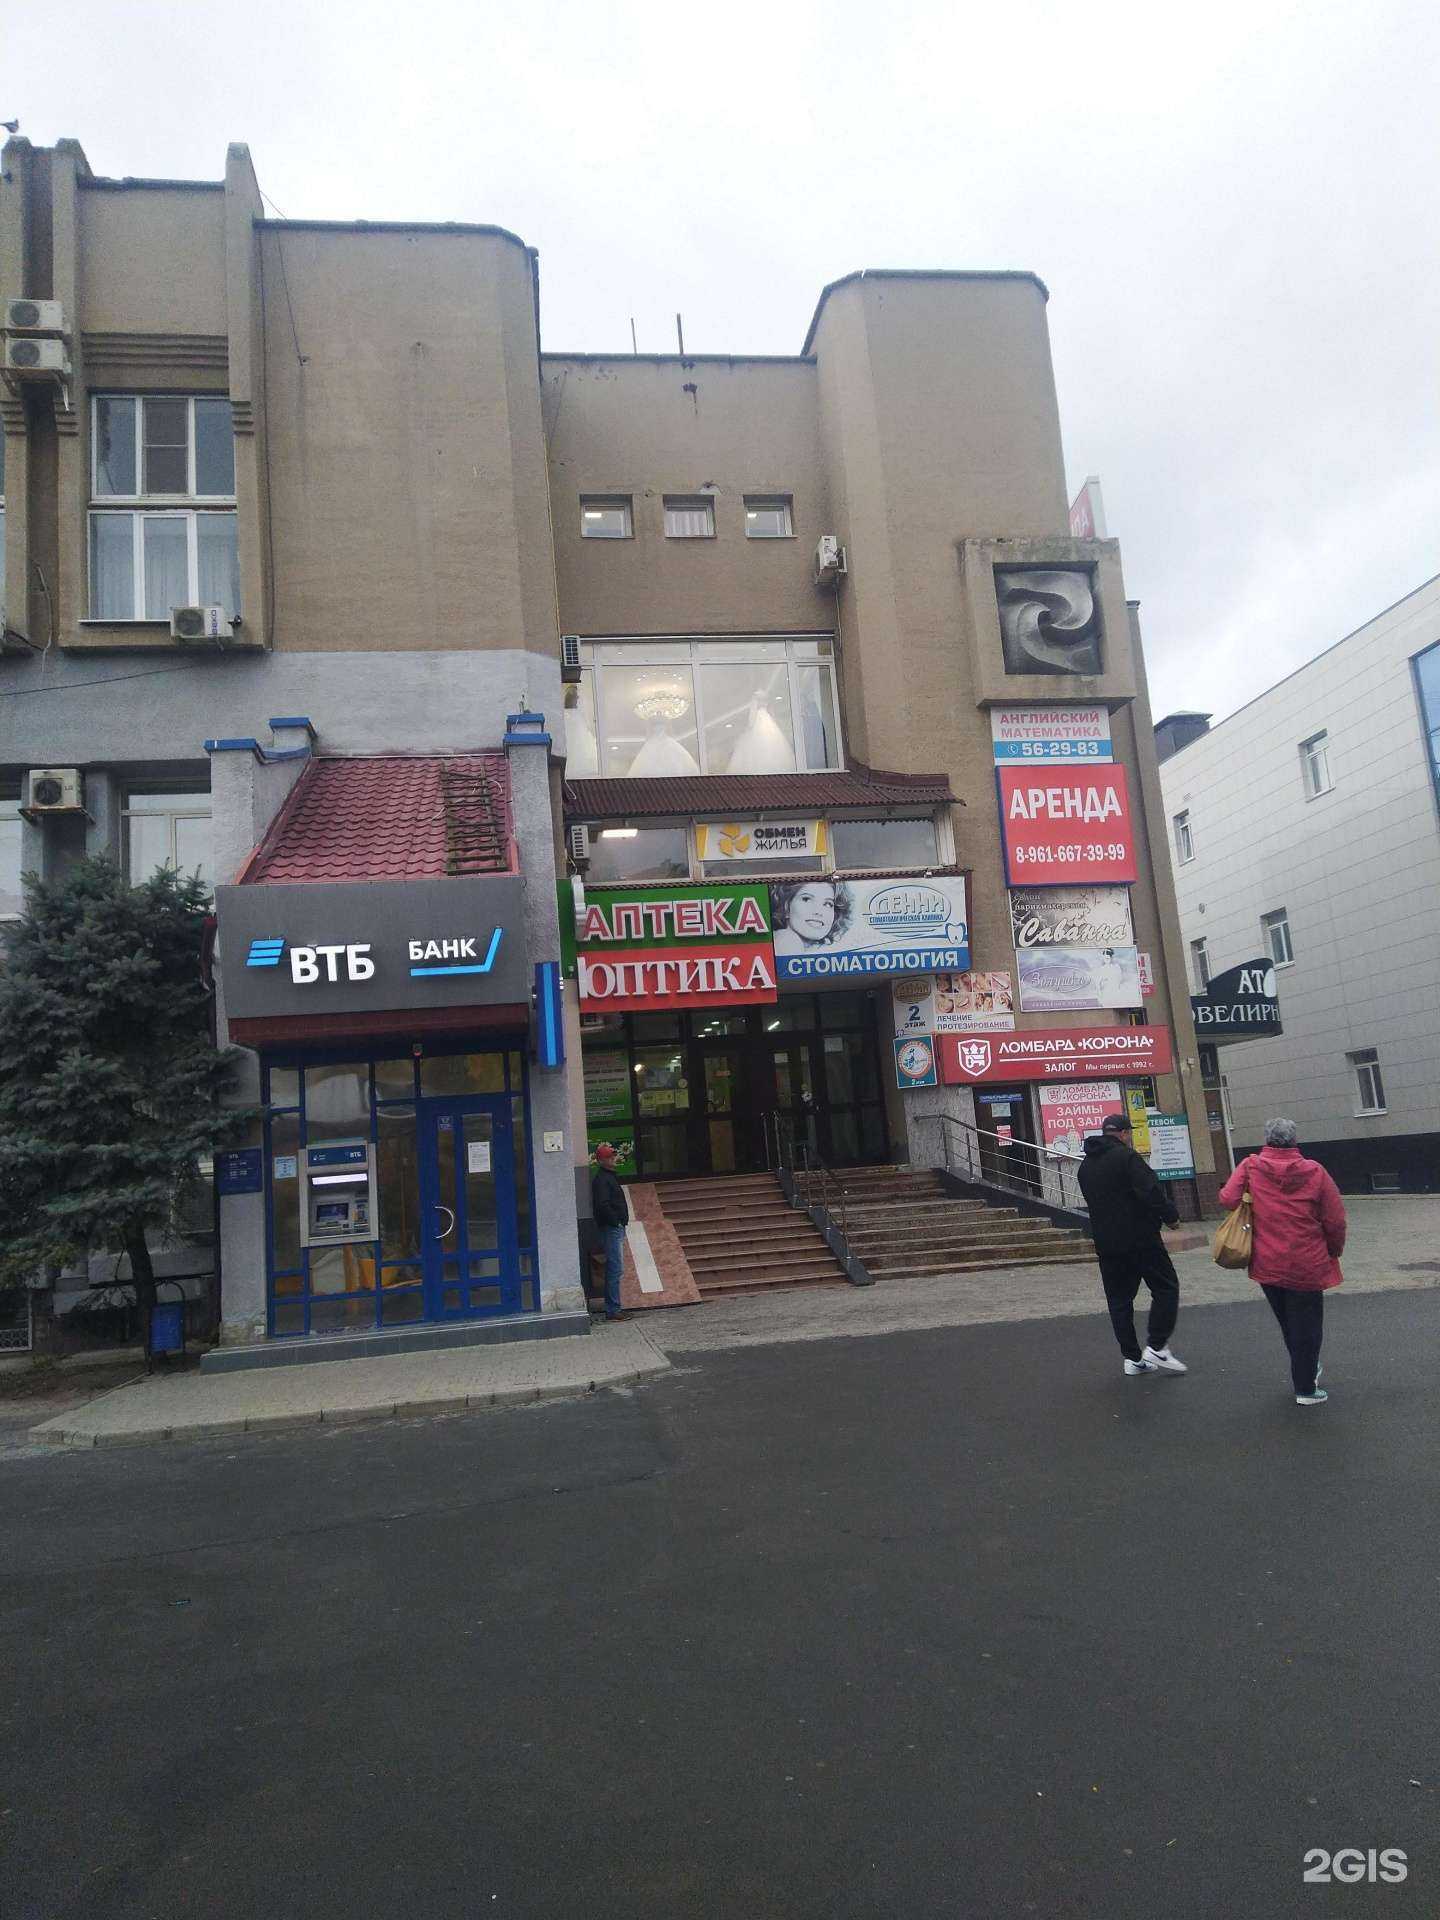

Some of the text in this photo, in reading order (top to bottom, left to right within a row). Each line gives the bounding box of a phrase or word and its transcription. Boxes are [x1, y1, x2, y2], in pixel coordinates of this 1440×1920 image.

[1000, 710, 1100, 725] АНГЛИЙСКИЙ
[1001, 726, 1102, 739] МАТЕМАТИКА
[1022, 741, 1099, 756] 56-29-83
[1009, 786, 1123, 823] АРЕНДА
[754, 827, 806, 839] ОБМЕН
[755, 838, 807, 851] ЖИЛЬЯ
[1016, 843, 1126, 863] 8-961-667-39-99
[584, 897, 769, 941] АПТЕКА
[408, 938, 478, 960] БАНК
[290, 944, 375, 984] ВТБ
[787, 950, 959, 975] СТОМАТОЛОГИЯ
[585, 955, 777, 998] ОПТИКА
[908, 1005, 920, 1021] 2
[936, 1014, 973, 1022] ЛЕЧЕНИЕ
[1192, 1004, 1280, 1024] ВЕЛИРН
[937, 1021, 1010, 1031] ПРОТЕЗИРОВАНИЕ
[999, 1039, 1076, 1054] ЛОМБАРД
[1045, 1062, 1077, 1073] ЗАЛОГ
[1085, 1063, 1098, 1071] Мы
[1099, 1062, 1125, 1071] первые
[1062, 1084, 1111, 1094] ЛОМБАРД
[1056, 1104, 1103, 1117] ЗАЙМЫ
[1048, 1118, 1075, 1129] ПОД
